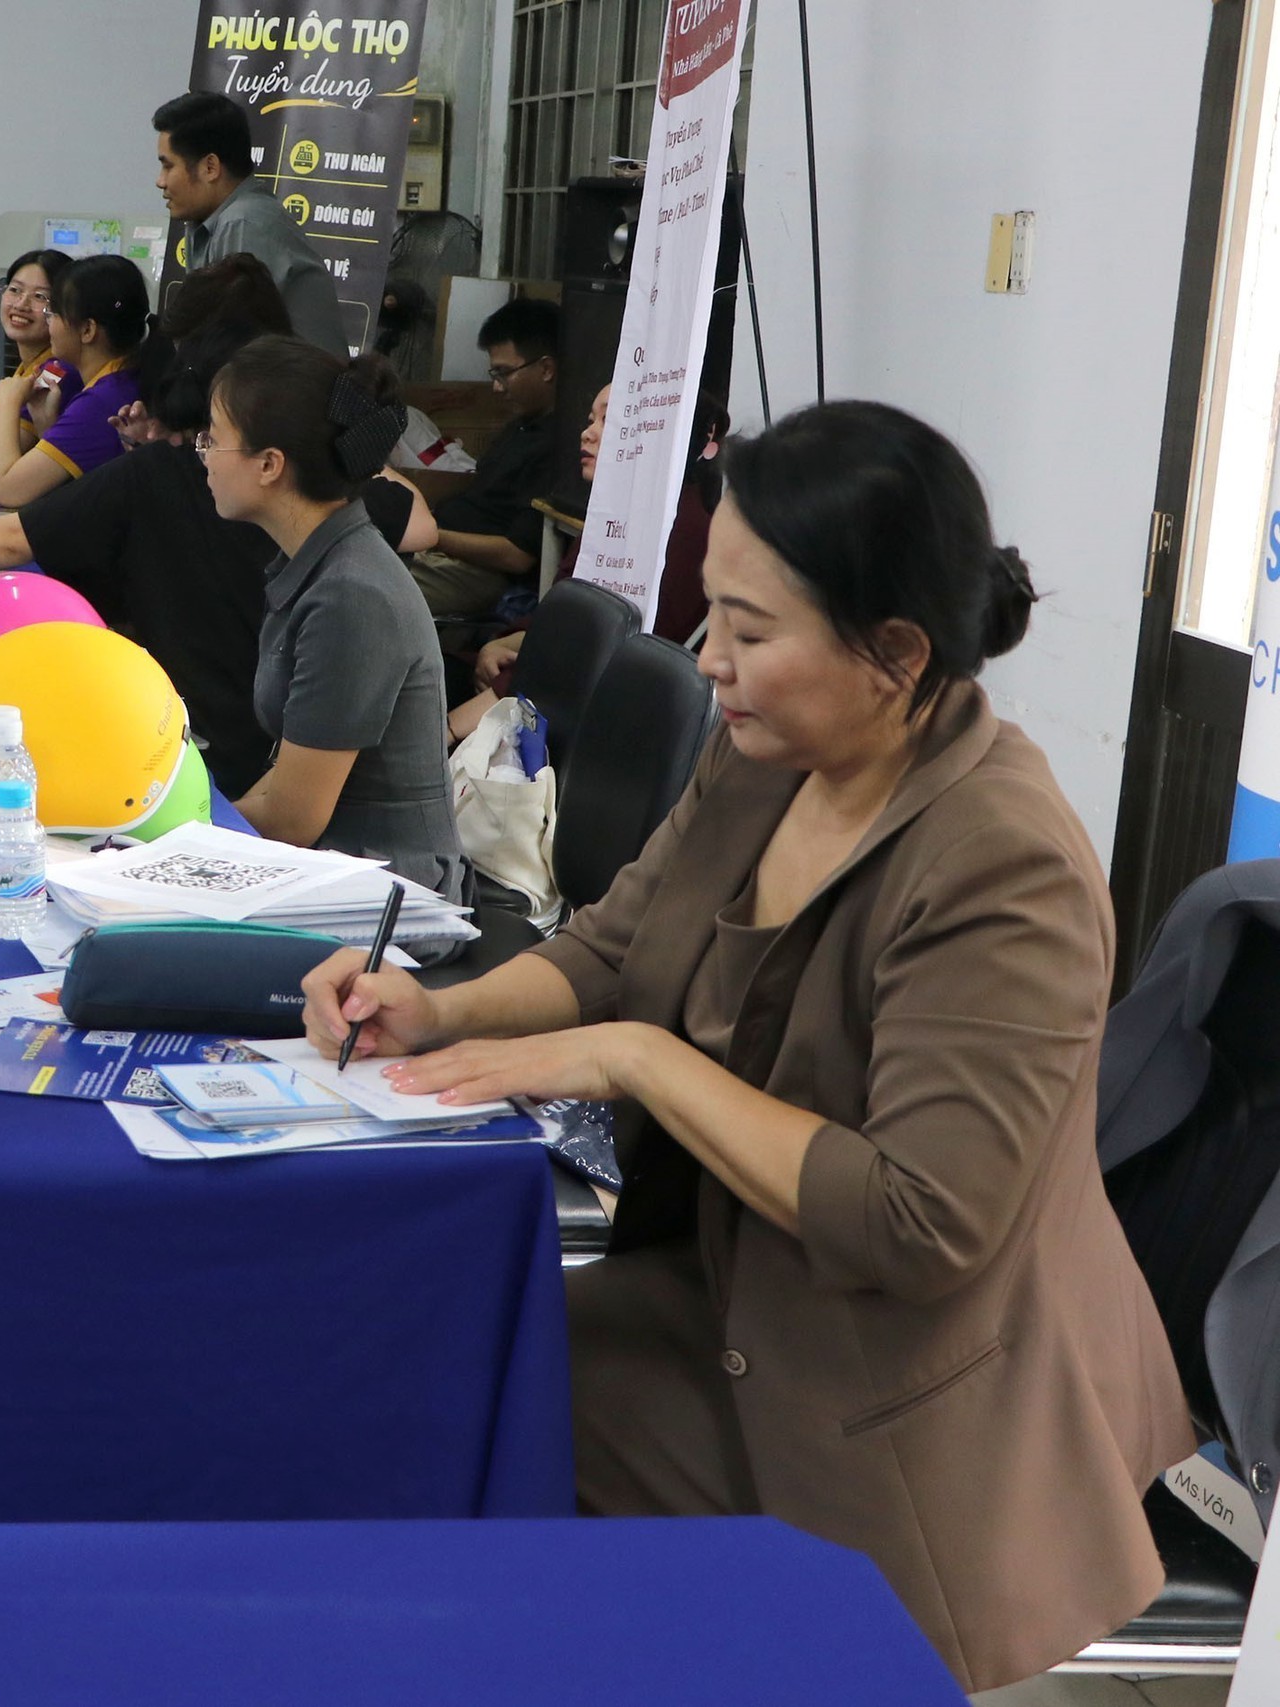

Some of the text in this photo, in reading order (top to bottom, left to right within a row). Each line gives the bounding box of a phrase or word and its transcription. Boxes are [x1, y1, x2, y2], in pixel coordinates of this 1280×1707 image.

[208, 10, 410, 64] PHÚC LỘC THỌ
[224, 55, 373, 109] Tuyển dụng
[324, 152, 386, 174] THU NGÂN
[314, 203, 375, 227] ĐÓNG GÓI
[334, 258, 351, 281] VỆ
[1174, 1469, 1235, 1526] Ms.Vân
